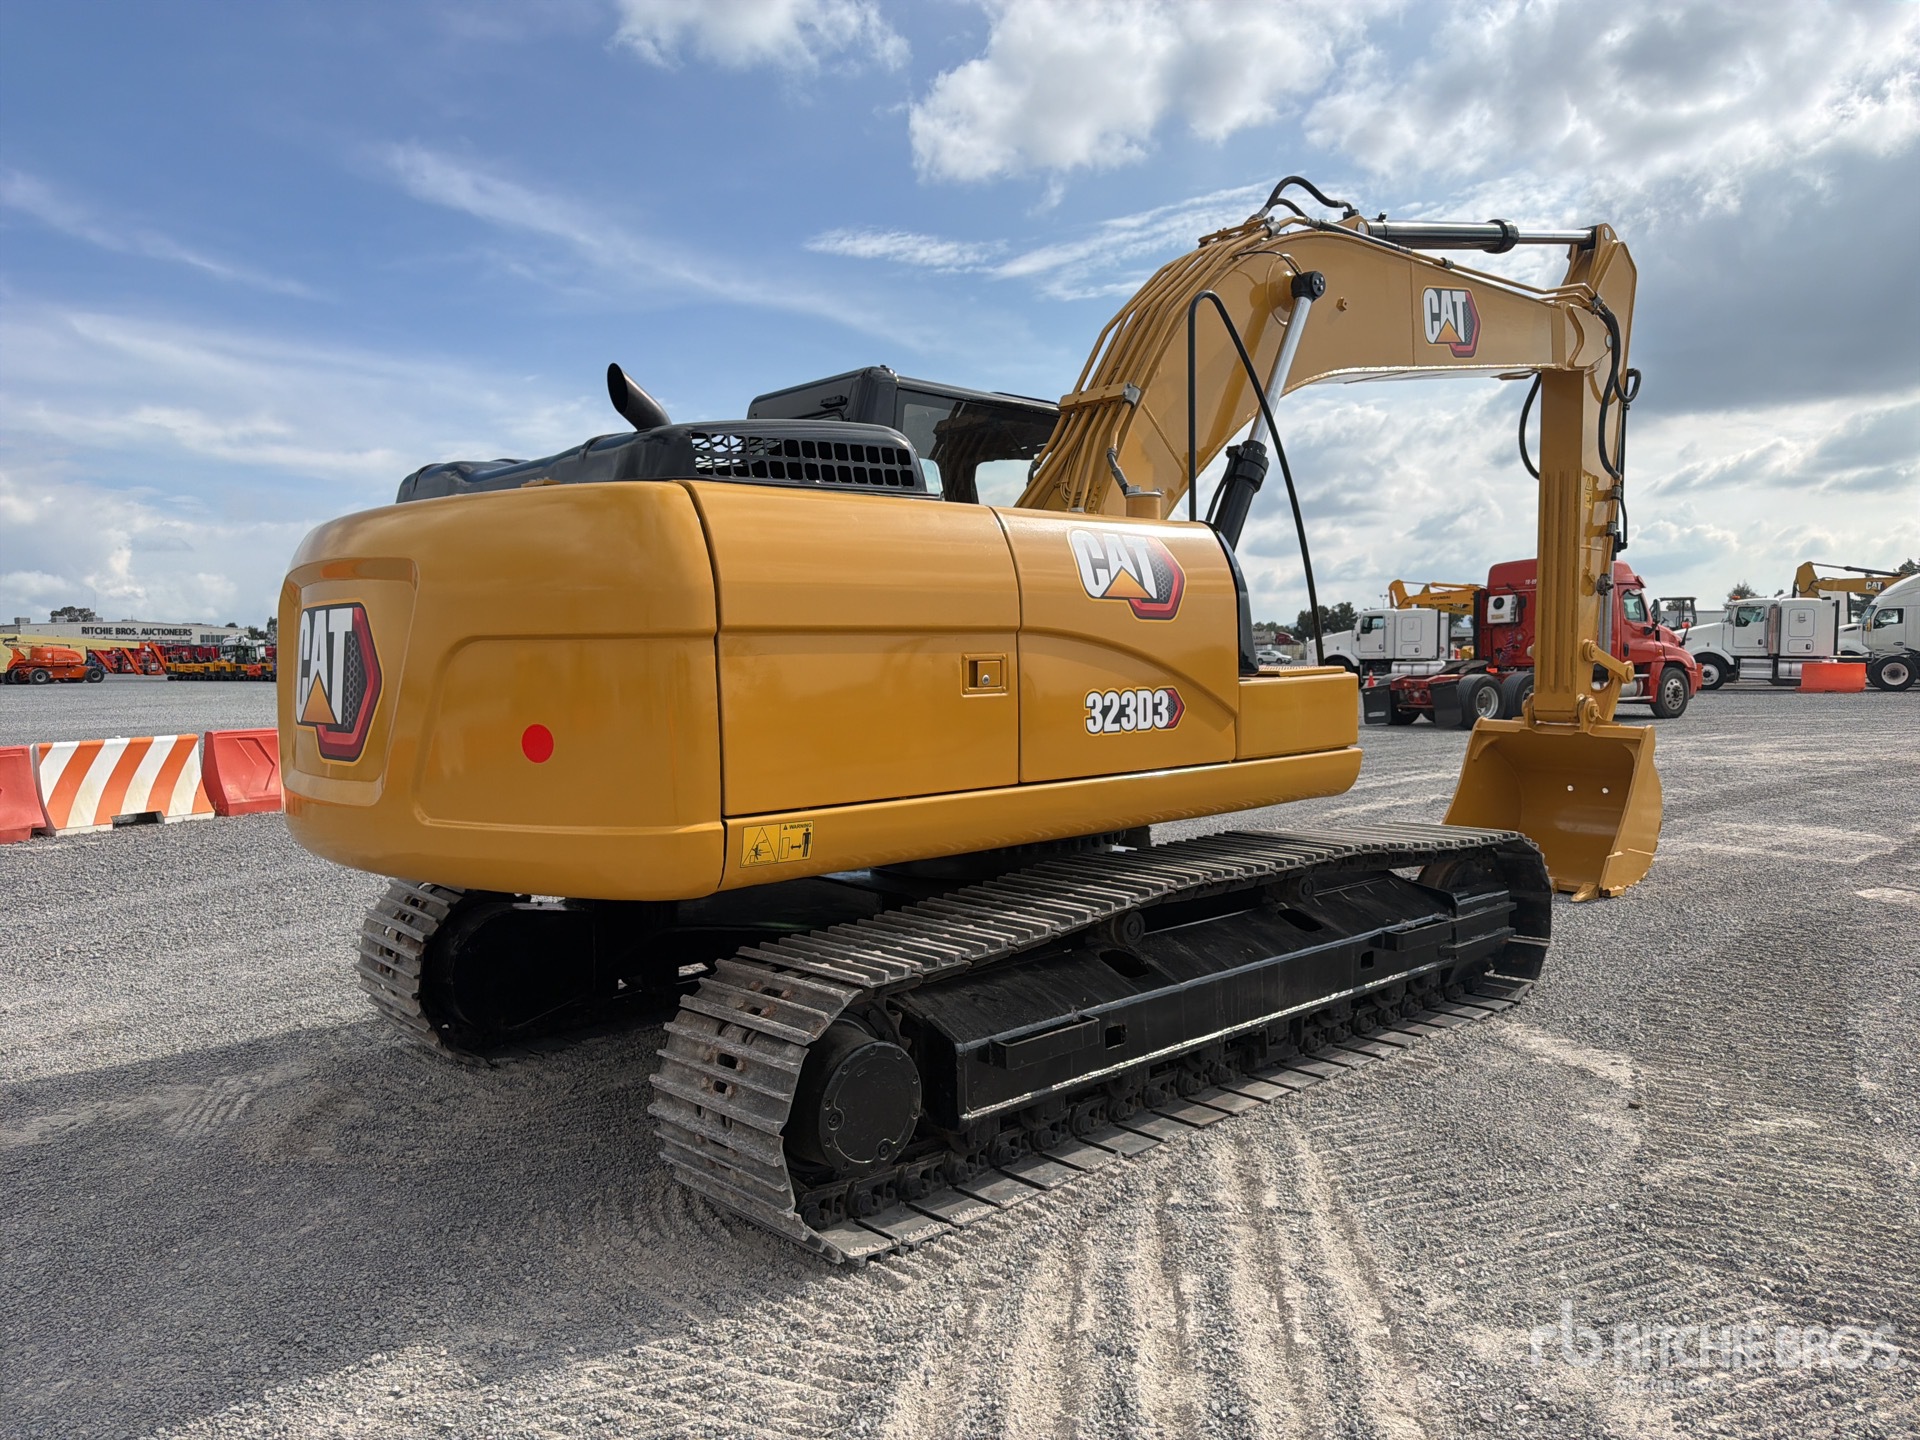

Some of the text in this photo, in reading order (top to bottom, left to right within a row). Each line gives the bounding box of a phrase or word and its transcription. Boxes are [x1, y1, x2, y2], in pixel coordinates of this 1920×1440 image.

[1423, 288, 1466, 344] CAT
[1069, 529, 1158, 600] CAT
[1865, 581, 1883, 590] CAT
[81, 626, 192, 637] RITCHIE BROS. AUCTIONEERS
[296, 607, 354, 725] CAT
[1085, 689, 1170, 734] 323D3
